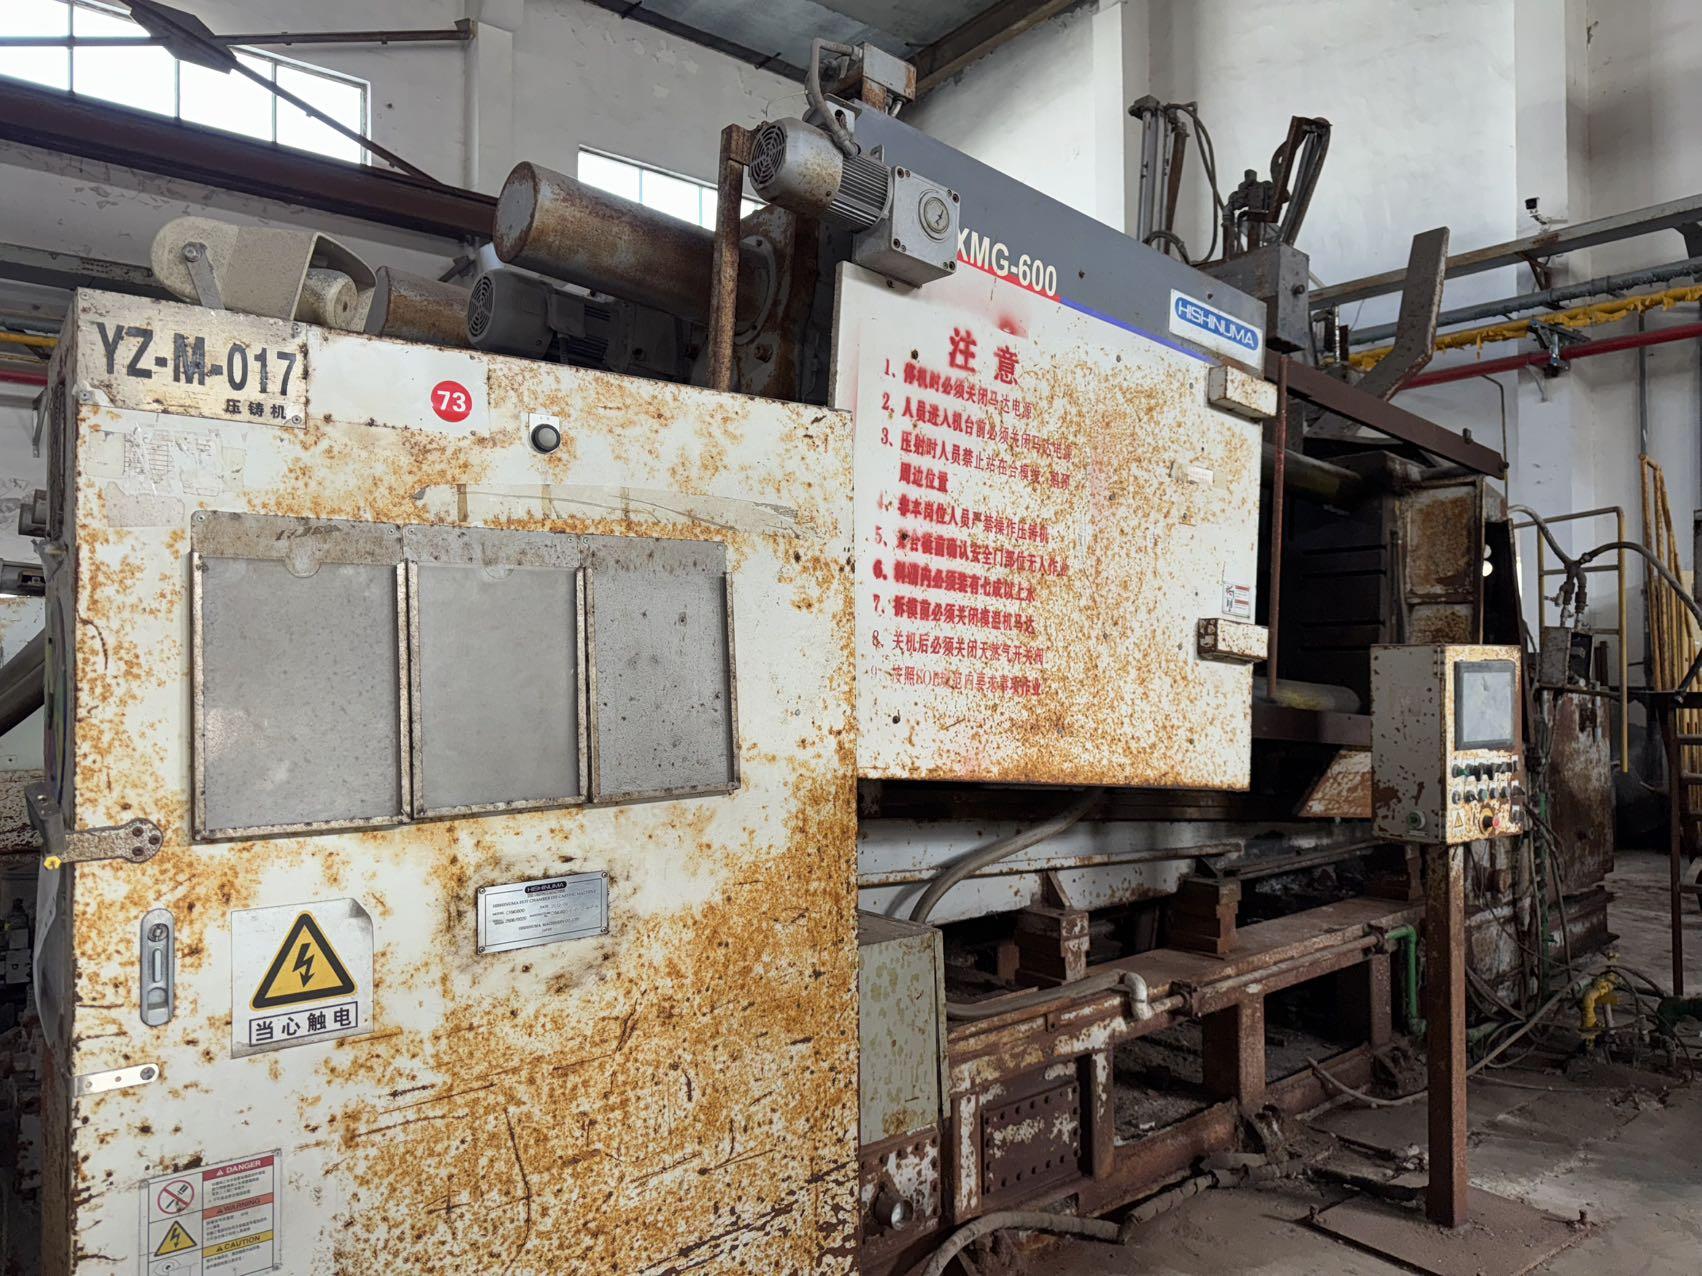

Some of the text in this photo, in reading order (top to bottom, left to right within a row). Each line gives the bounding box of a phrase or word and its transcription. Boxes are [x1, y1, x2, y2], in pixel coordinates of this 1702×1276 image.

[1178, 300, 1255, 347] HISHINUMA
[95, 322, 297, 396] YZ-M-017
[948, 326, 1020, 385] 注意
[225, 399, 287, 420] 压铸机
[437, 390, 467, 412] 73
[898, 461, 949, 493] 周边位置
[256, 1007, 351, 1042] 当心触电
[226, 1160, 262, 1175] DANGER
[224, 1198, 261, 1212] WARNING
[224, 1235, 261, 1250] CAUTION
